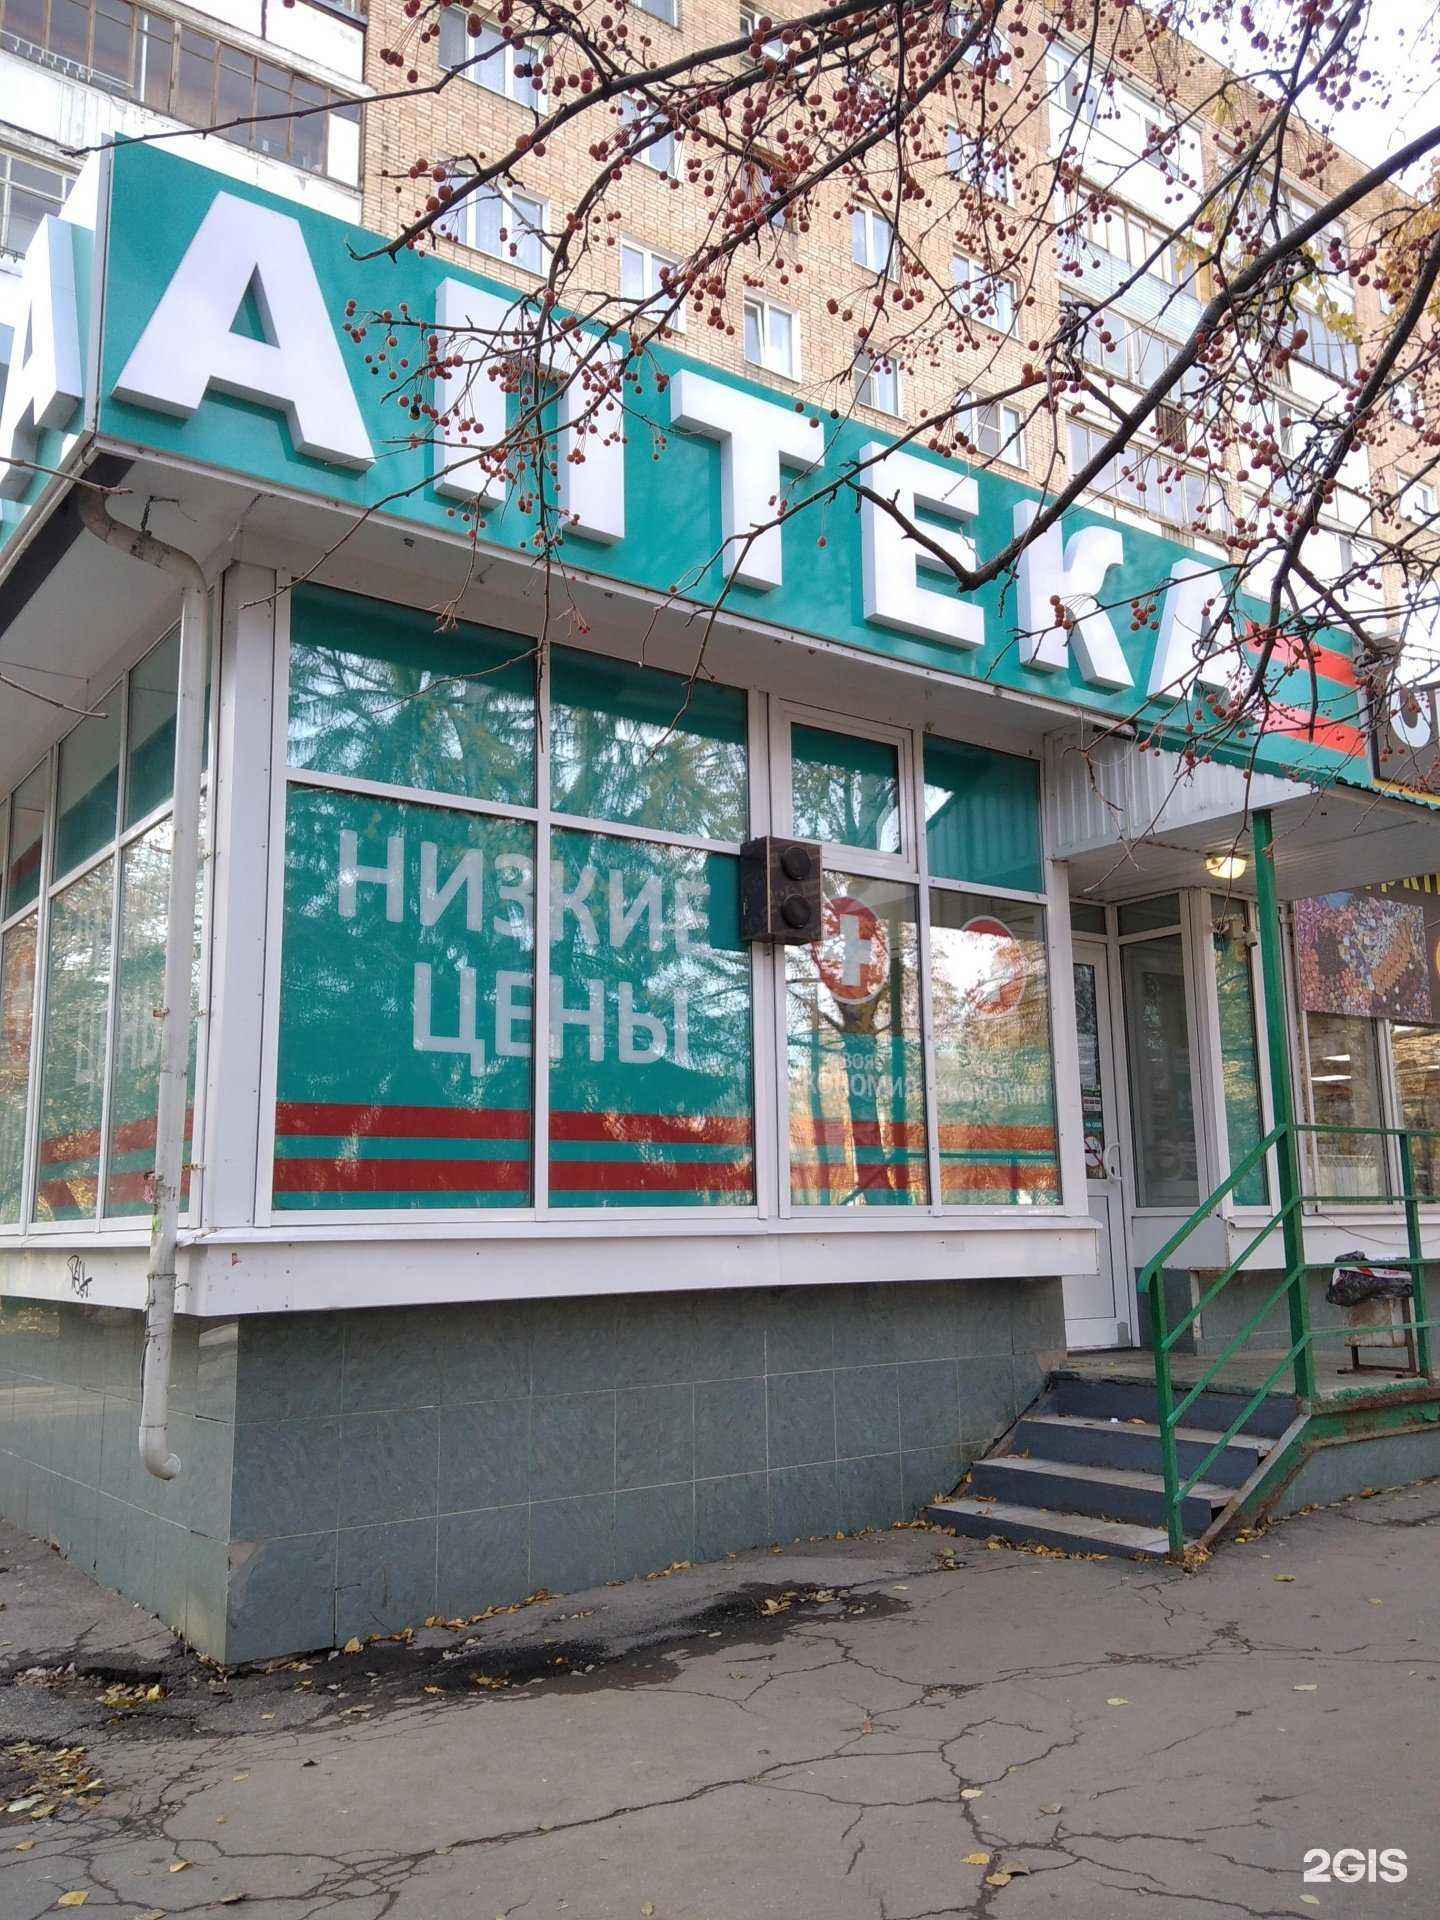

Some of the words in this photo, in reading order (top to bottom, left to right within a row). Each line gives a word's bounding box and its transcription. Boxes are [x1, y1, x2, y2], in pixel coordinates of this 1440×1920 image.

[112, 190, 1254, 718] АПТЕКА
[338, 829, 711, 953] НИЗКИЕ
[412, 962, 690, 1077] ЦЕНЫ
